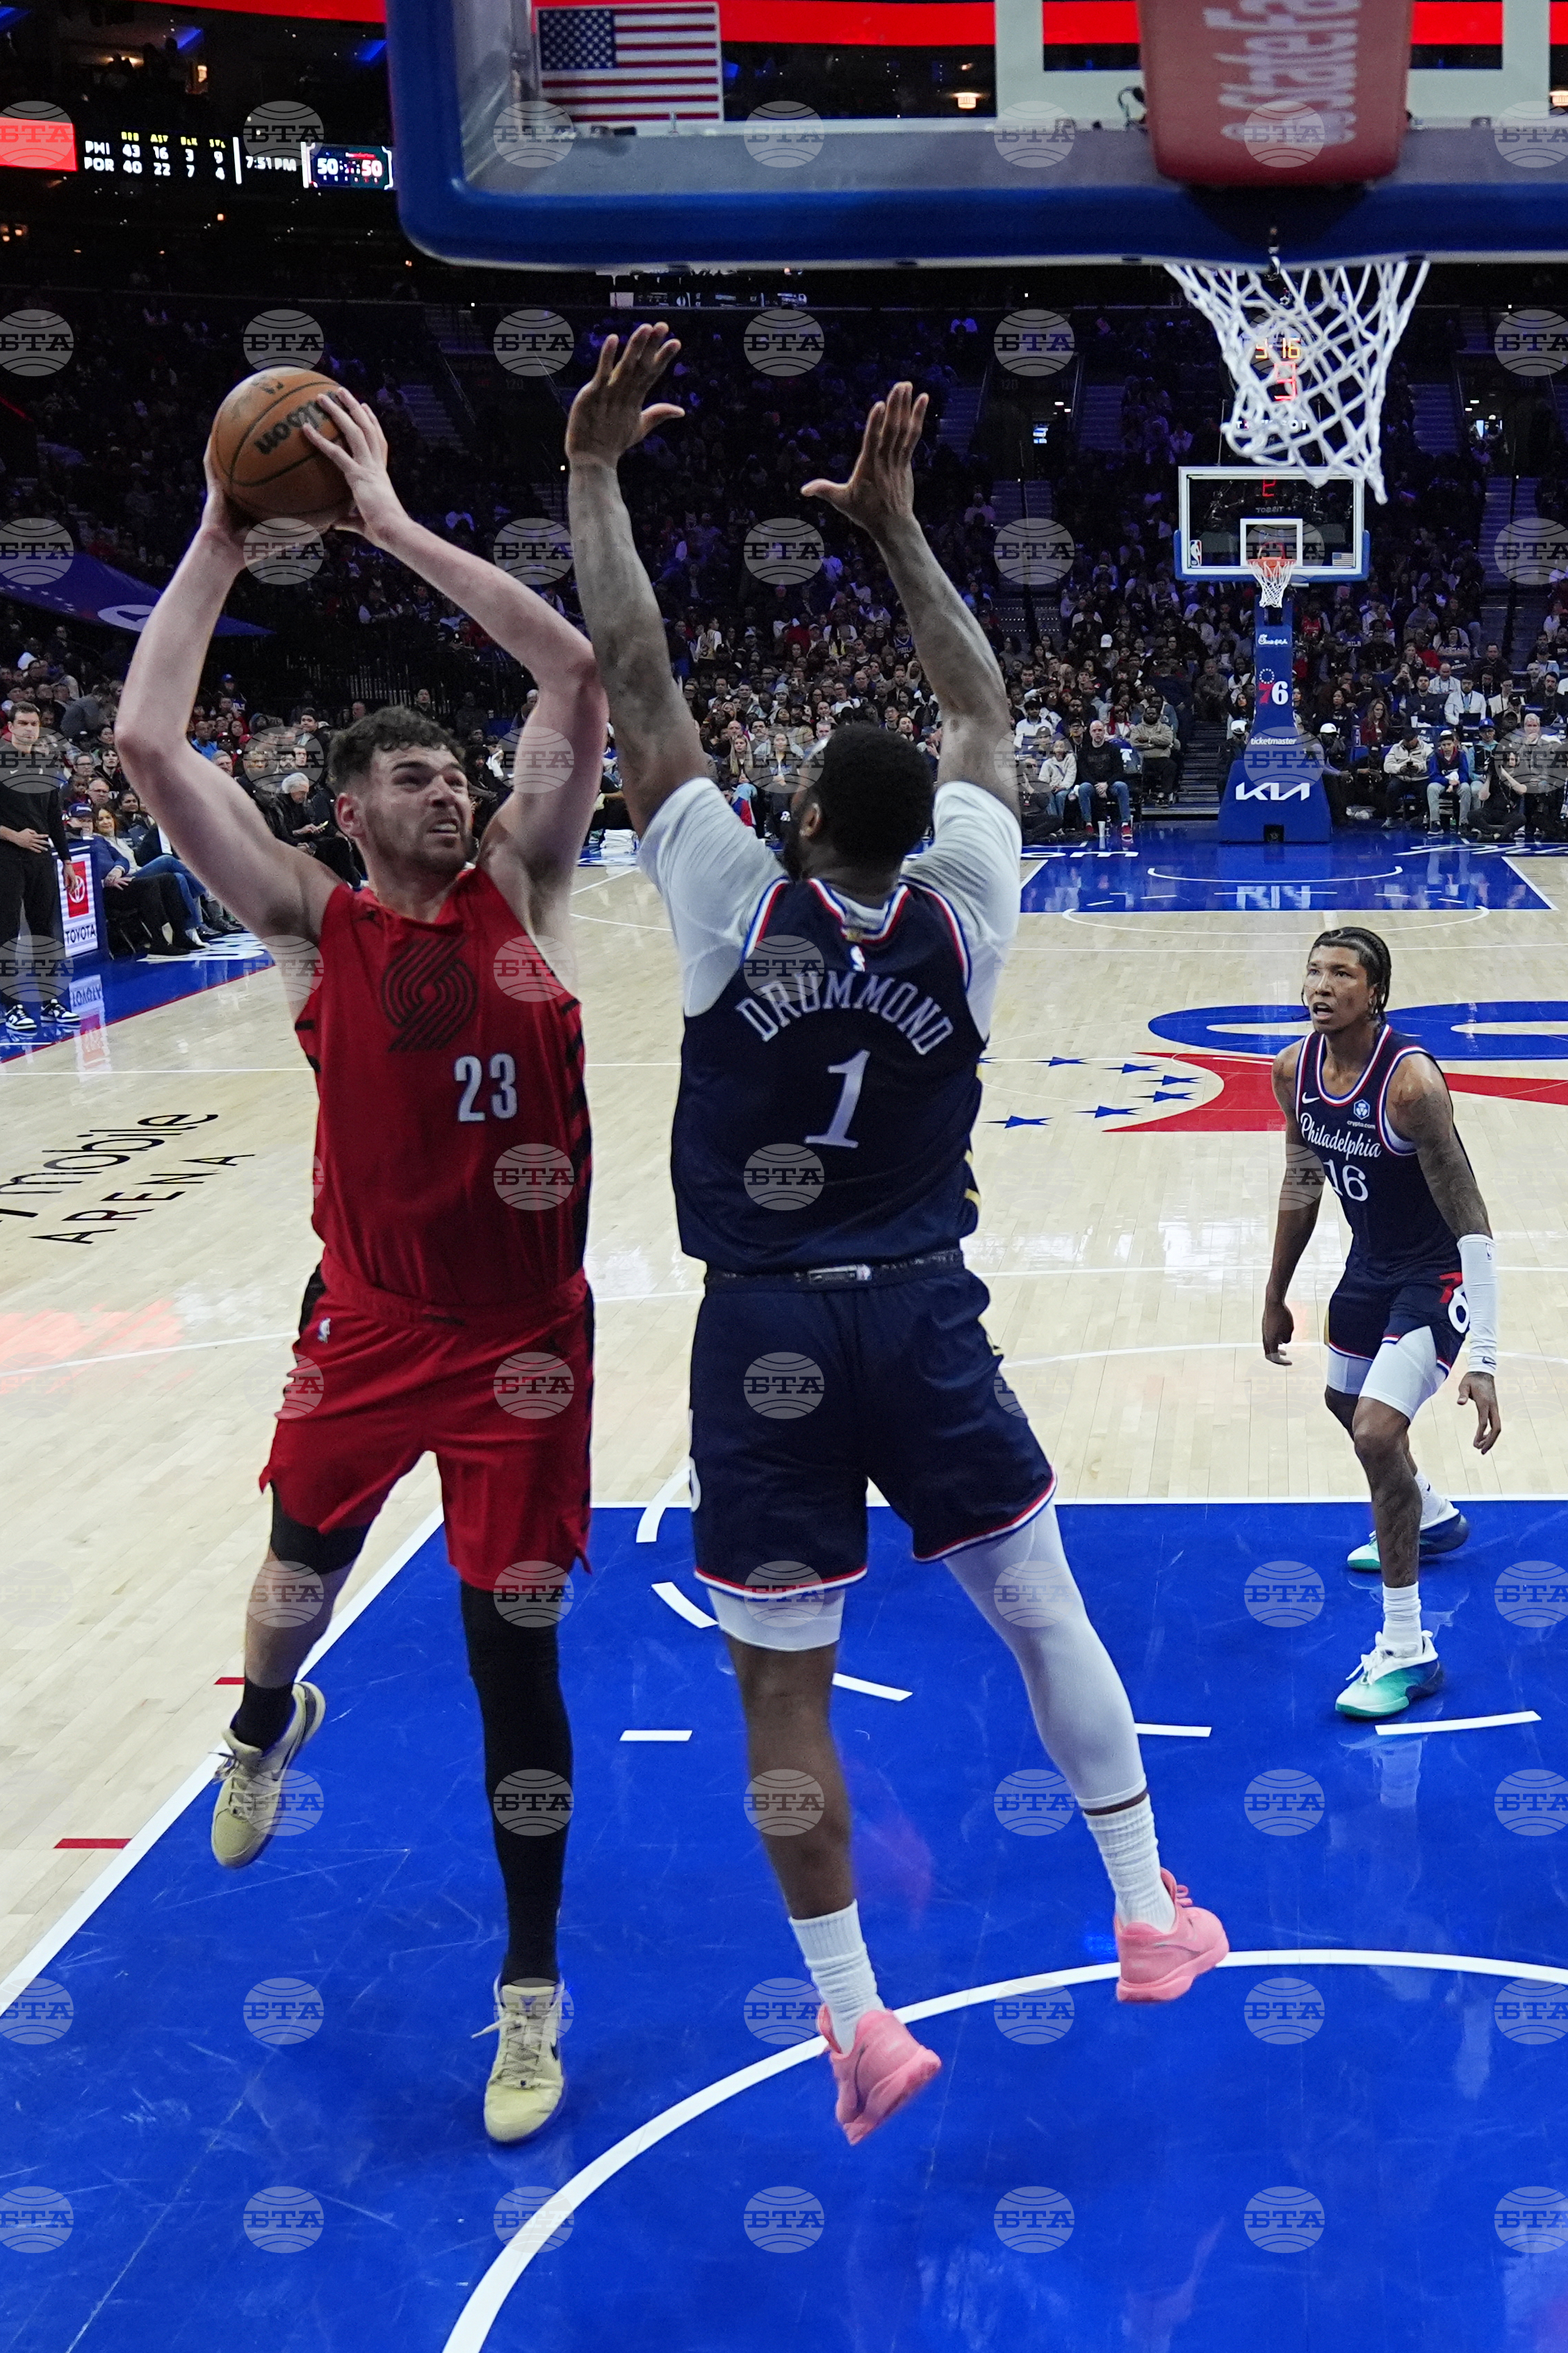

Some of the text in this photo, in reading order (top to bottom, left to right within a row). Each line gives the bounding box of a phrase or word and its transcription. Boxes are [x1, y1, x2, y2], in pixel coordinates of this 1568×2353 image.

[85, 140, 223, 164] PHI 43 16 3 9
[245, 156, 297, 172] 7:51 PM
[84, 156, 225, 180] POR 40 22 7 4
[317, 158, 338, 174] 50
[361, 160, 383, 177] 50
[1259, 681, 1289, 706] 76
[1251, 737, 1297, 745] ticketmaster
[65, 924, 97, 944] TOYOTA
[735, 970, 953, 1056] DRUMMOND
[454, 1052, 518, 1123] 23
[803, 1048, 871, 1149] 1
[1300, 1112, 1382, 1162] Philadelphia
[1346, 1120, 1376, 1130] crypto.com
[1323, 1159, 1369, 1202] 16
[28, 1154, 256, 1244] ARENA
